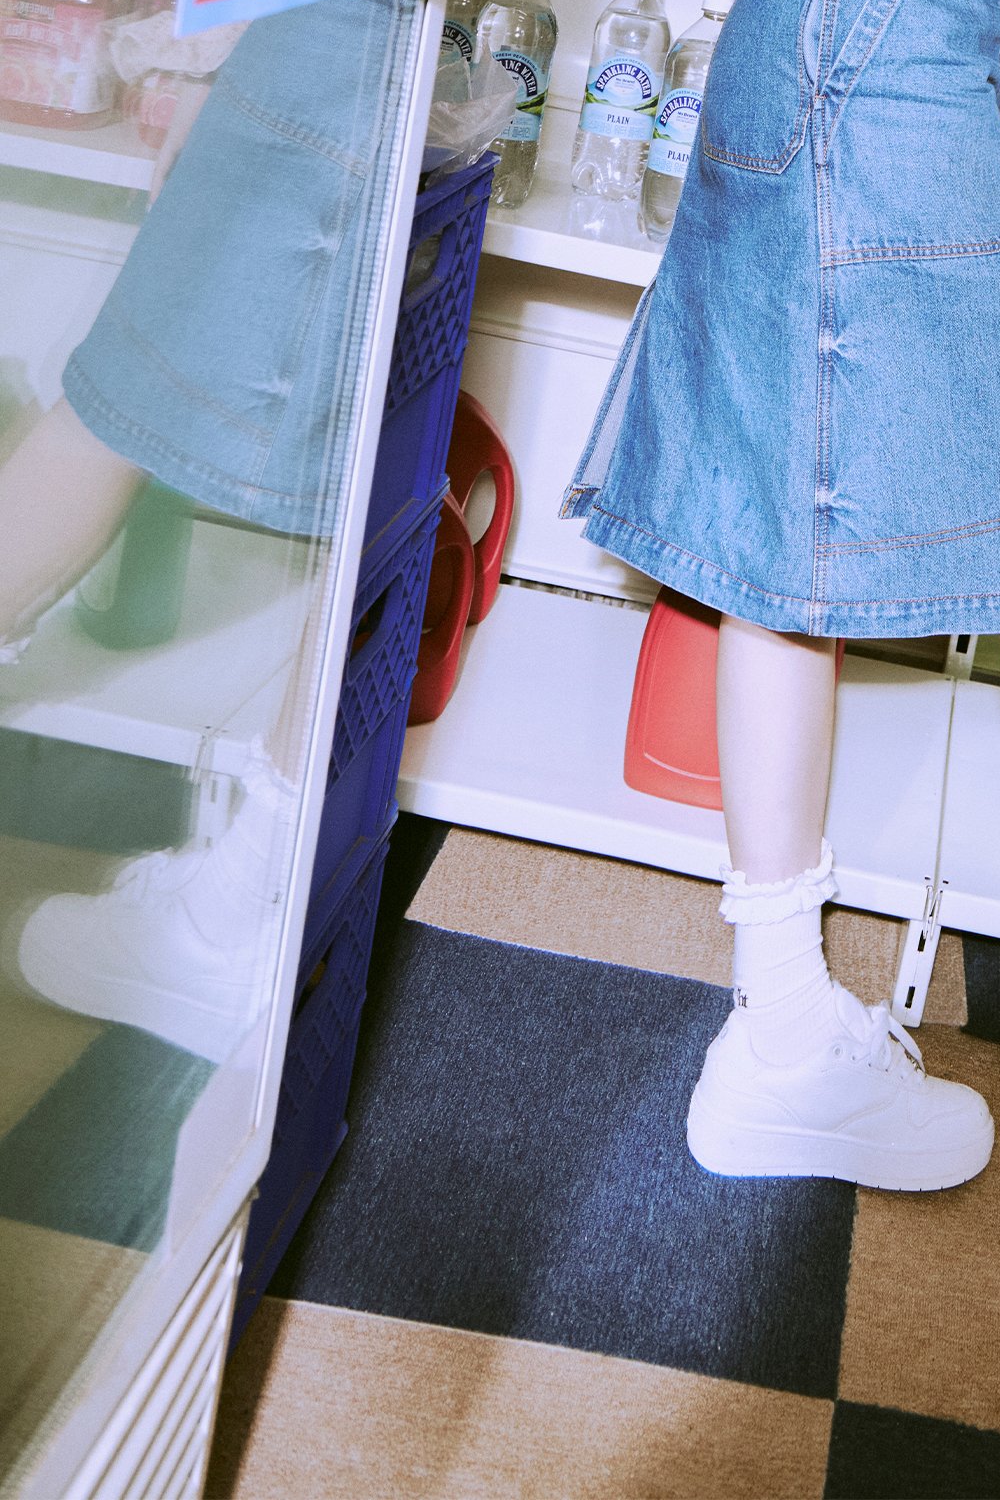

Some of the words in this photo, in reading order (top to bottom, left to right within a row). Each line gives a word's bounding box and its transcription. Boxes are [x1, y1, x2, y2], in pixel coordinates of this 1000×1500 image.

[597, 64, 638, 90] SPARKLING
[635, 70, 652, 96] WATER
[607, 114, 630, 125] PLAIN
